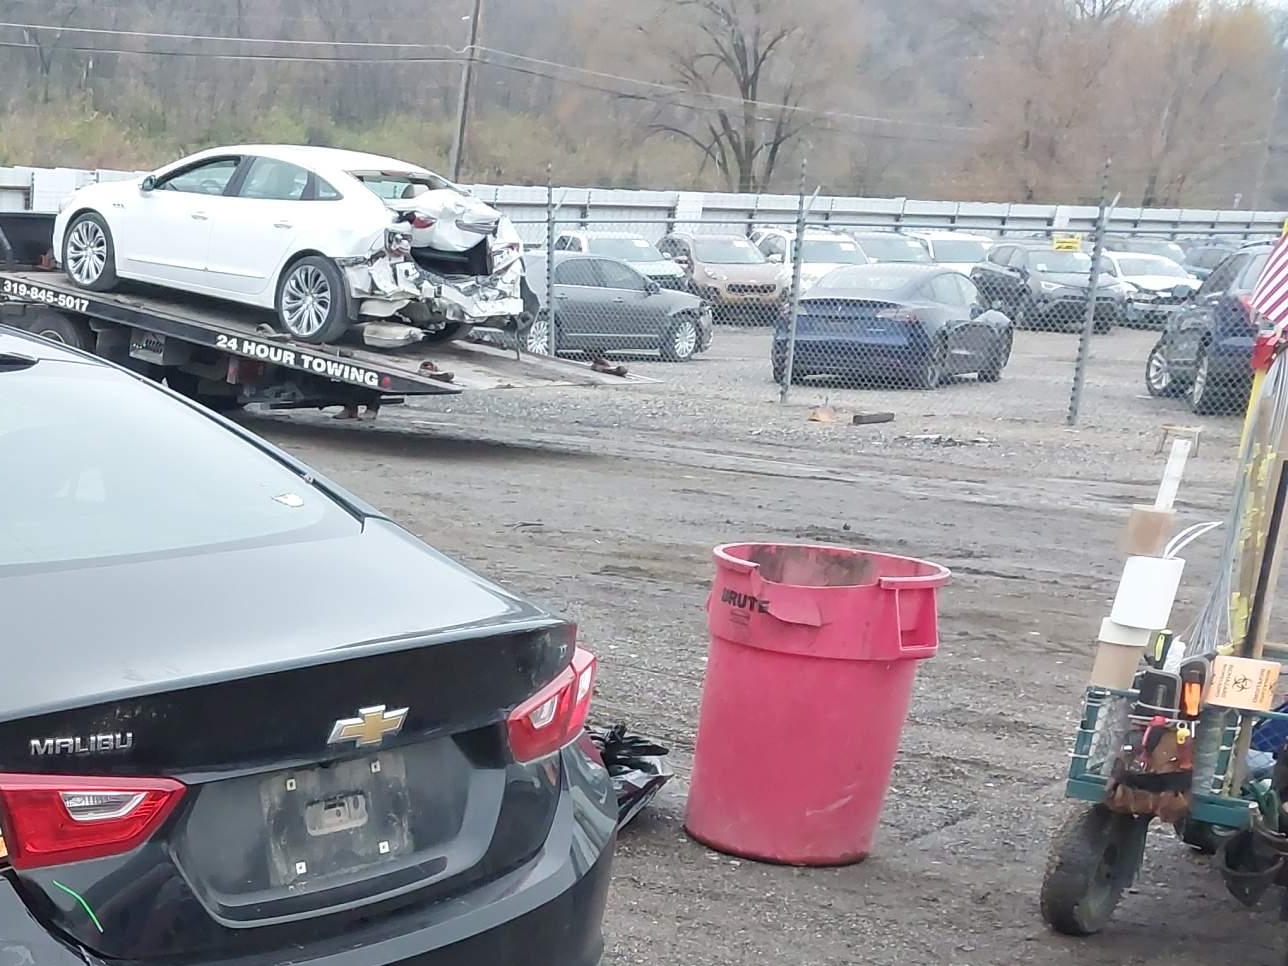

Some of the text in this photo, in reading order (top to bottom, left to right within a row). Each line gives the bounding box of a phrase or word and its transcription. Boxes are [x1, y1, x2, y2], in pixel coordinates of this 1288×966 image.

[4, 279, 90, 312] 319-845-5017
[215, 335, 380, 387] 24 HOUR TOWING
[722, 587, 770, 614] BRUTE
[30, 733, 133, 756] MALIBU
